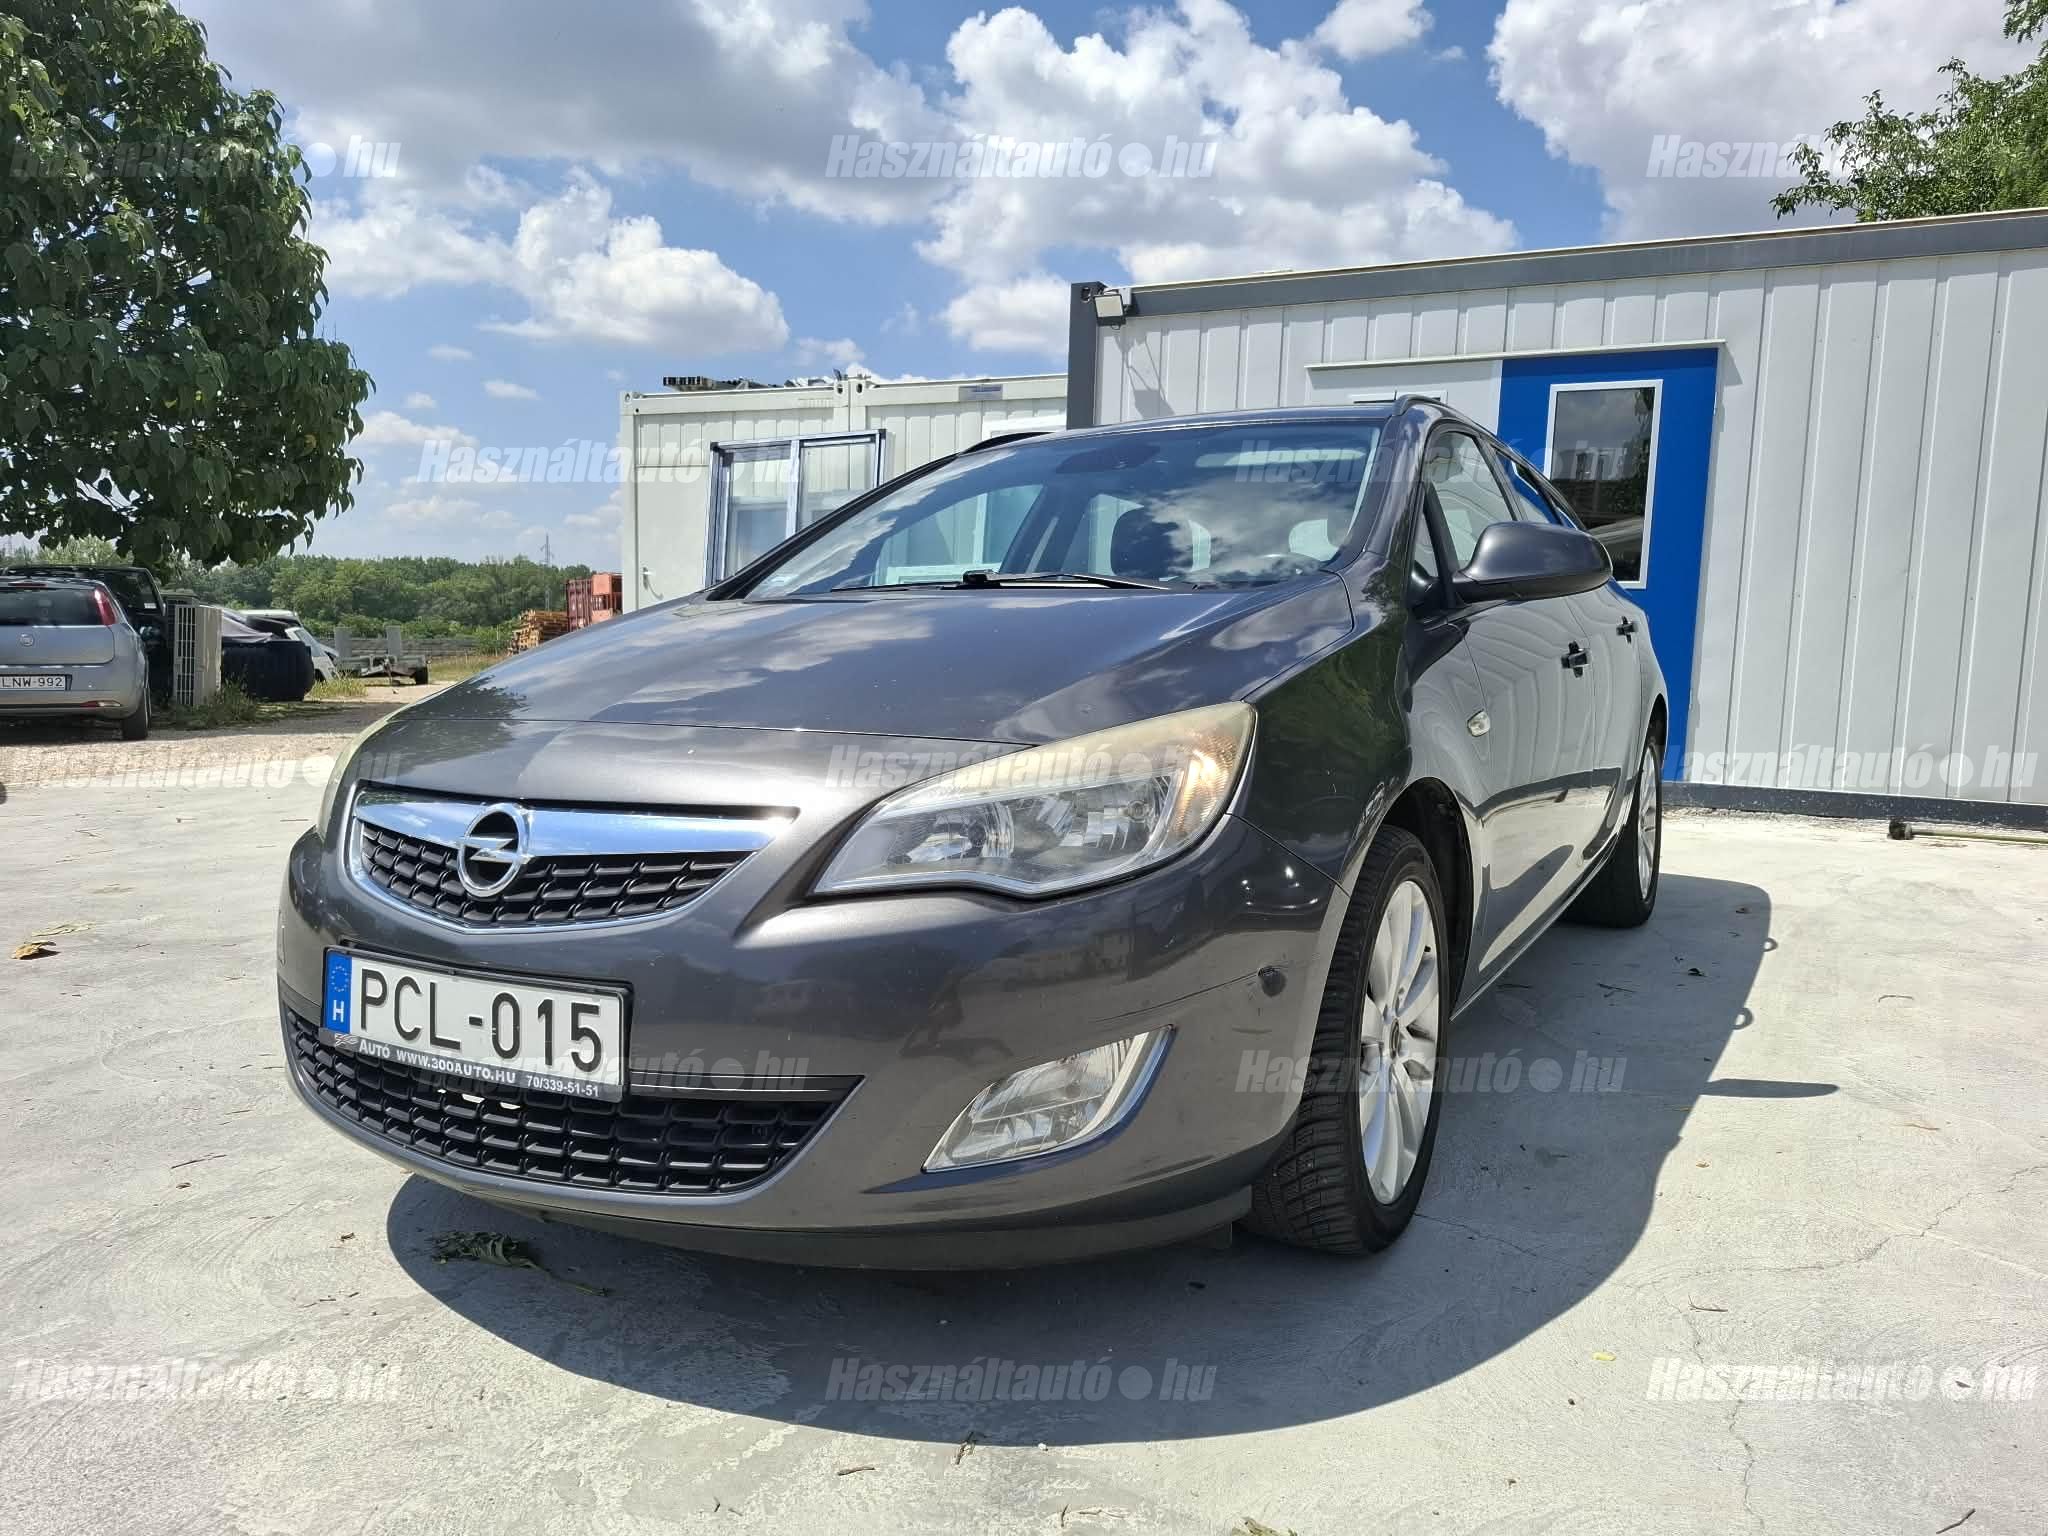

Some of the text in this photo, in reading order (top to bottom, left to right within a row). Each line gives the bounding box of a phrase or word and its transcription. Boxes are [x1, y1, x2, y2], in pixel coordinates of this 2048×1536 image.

[332, 1000, 345, 1023] H
[359, 967, 602, 1073] PCL-015
[526, 1075, 599, 1097] 70/339-51-51
